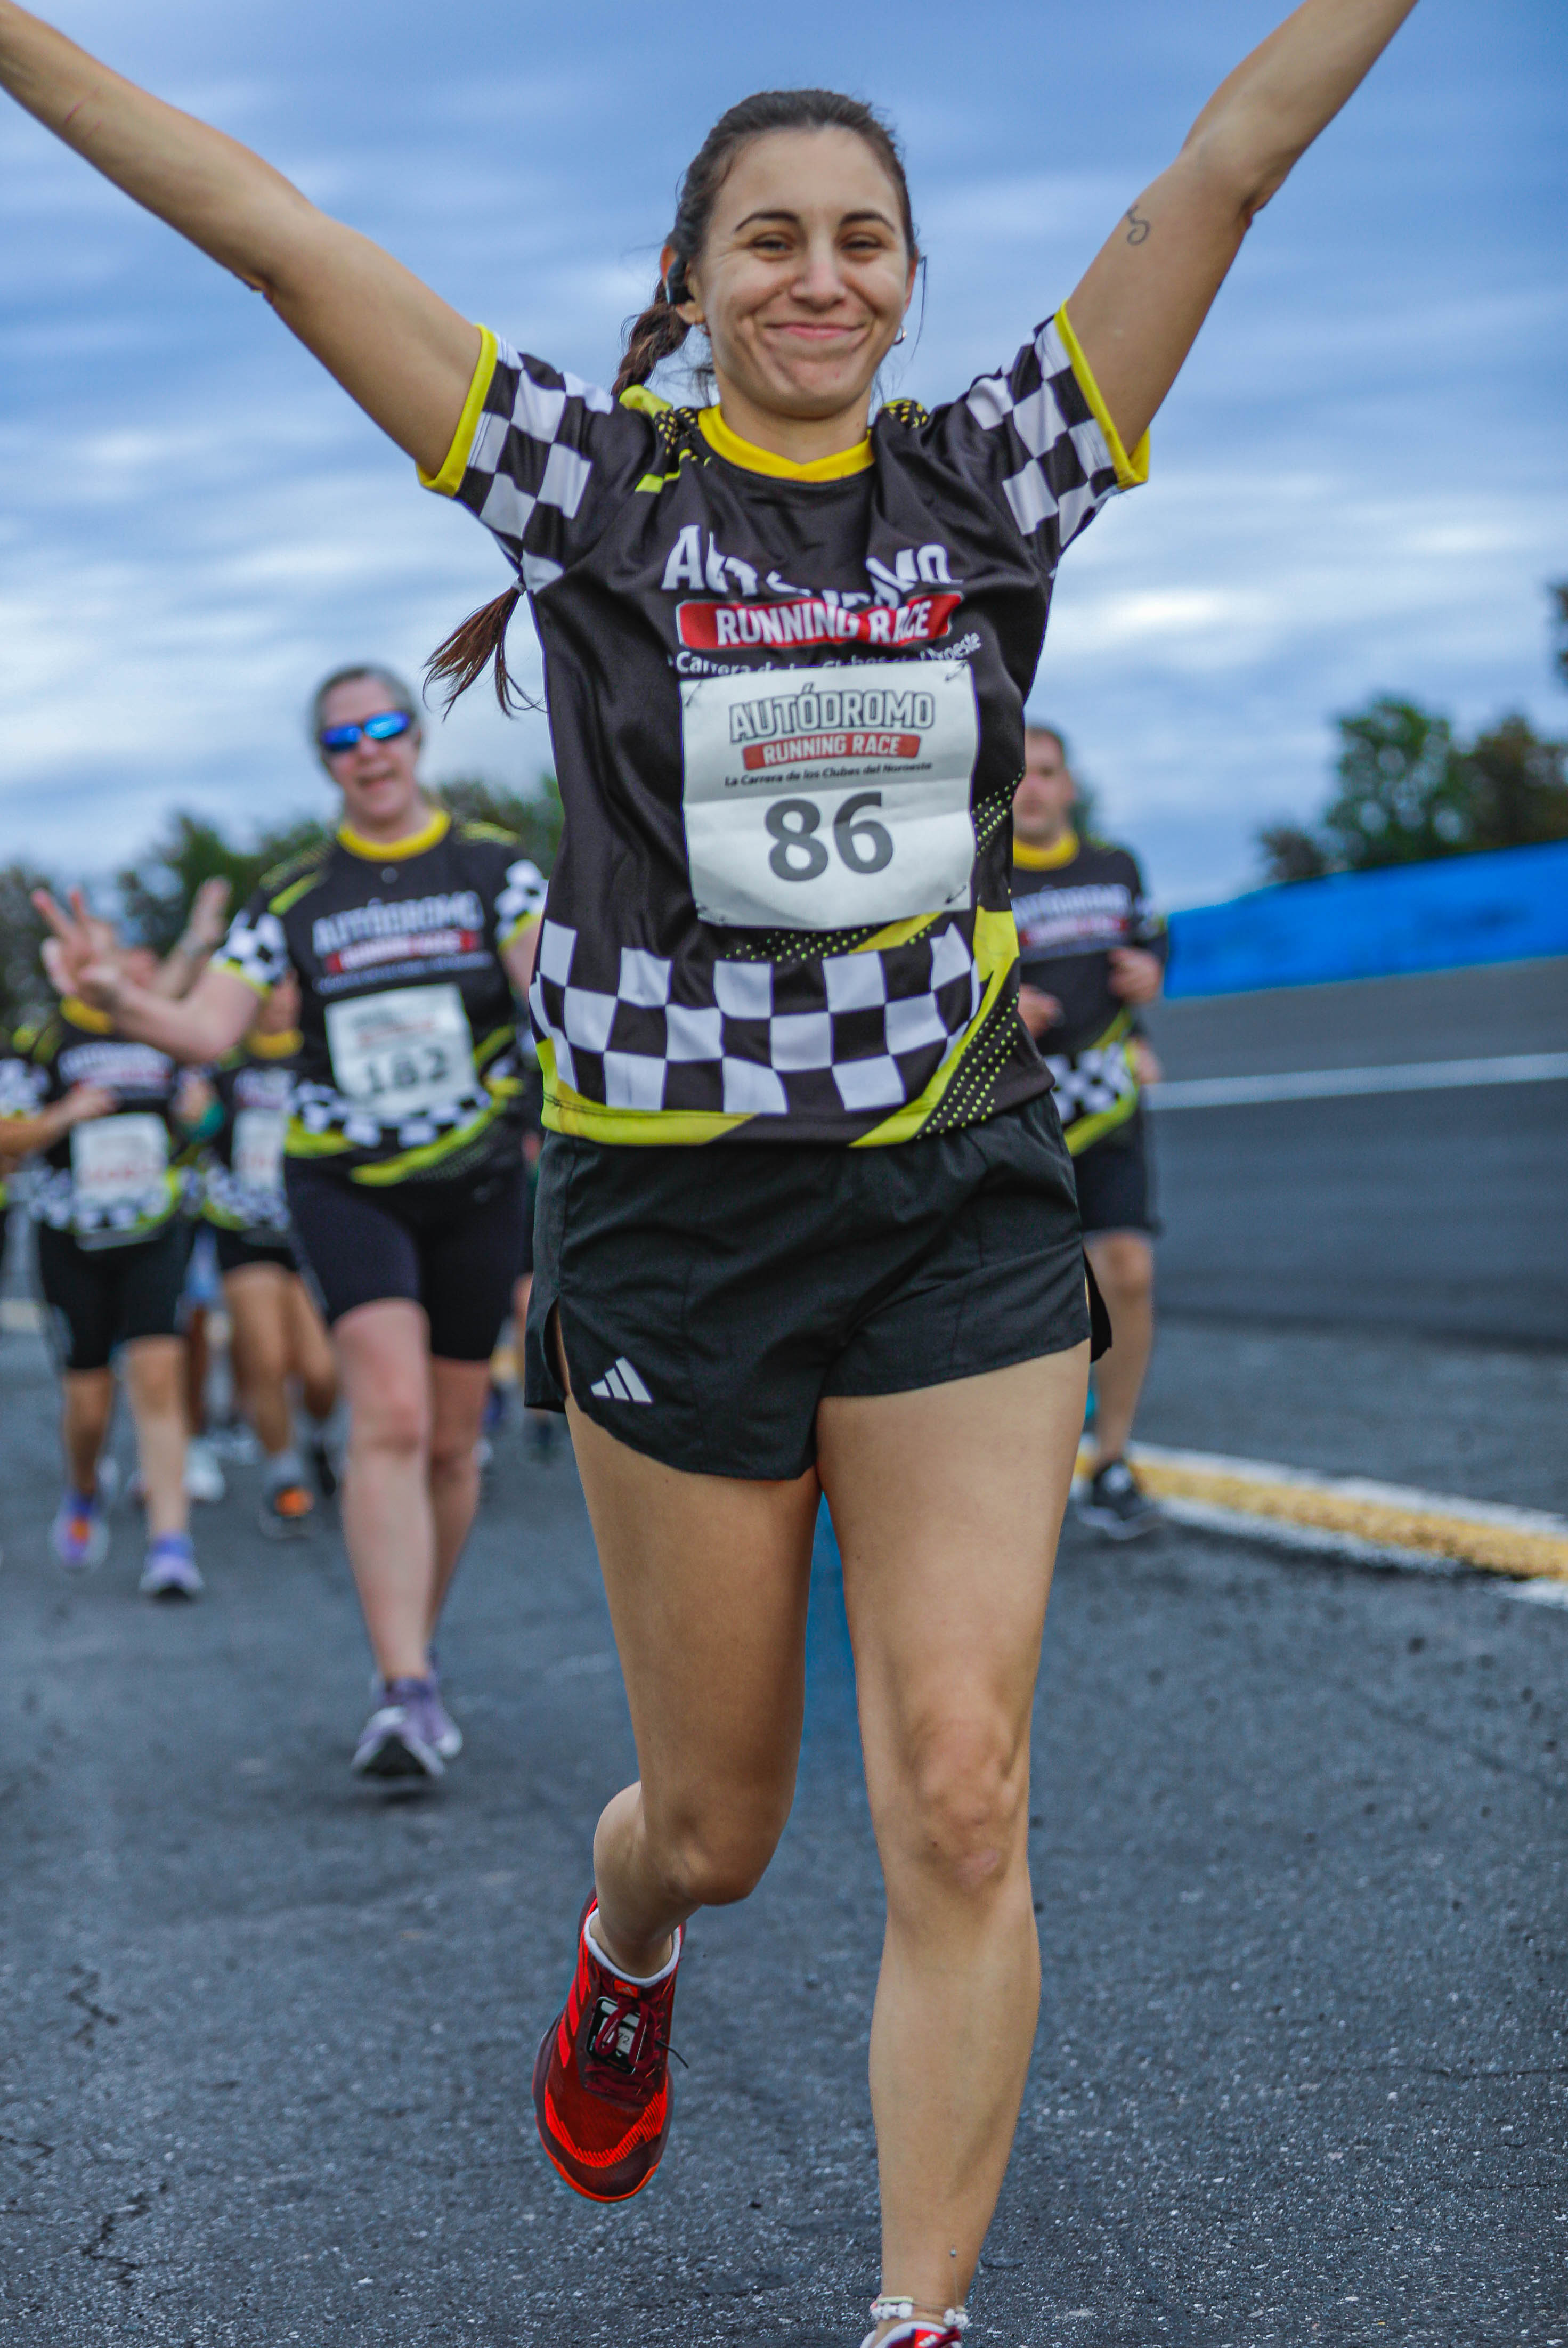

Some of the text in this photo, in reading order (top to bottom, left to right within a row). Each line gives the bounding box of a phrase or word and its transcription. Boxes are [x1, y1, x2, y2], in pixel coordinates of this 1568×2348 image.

[716, 602, 861, 645] RUNNING
[728, 681, 936, 743] AUTÓDROMO
[762, 734, 901, 767] RUNNING RACE
[725, 761, 932, 786] La Carrera de los Clubes del Noroeste
[764, 791, 893, 882] 86
